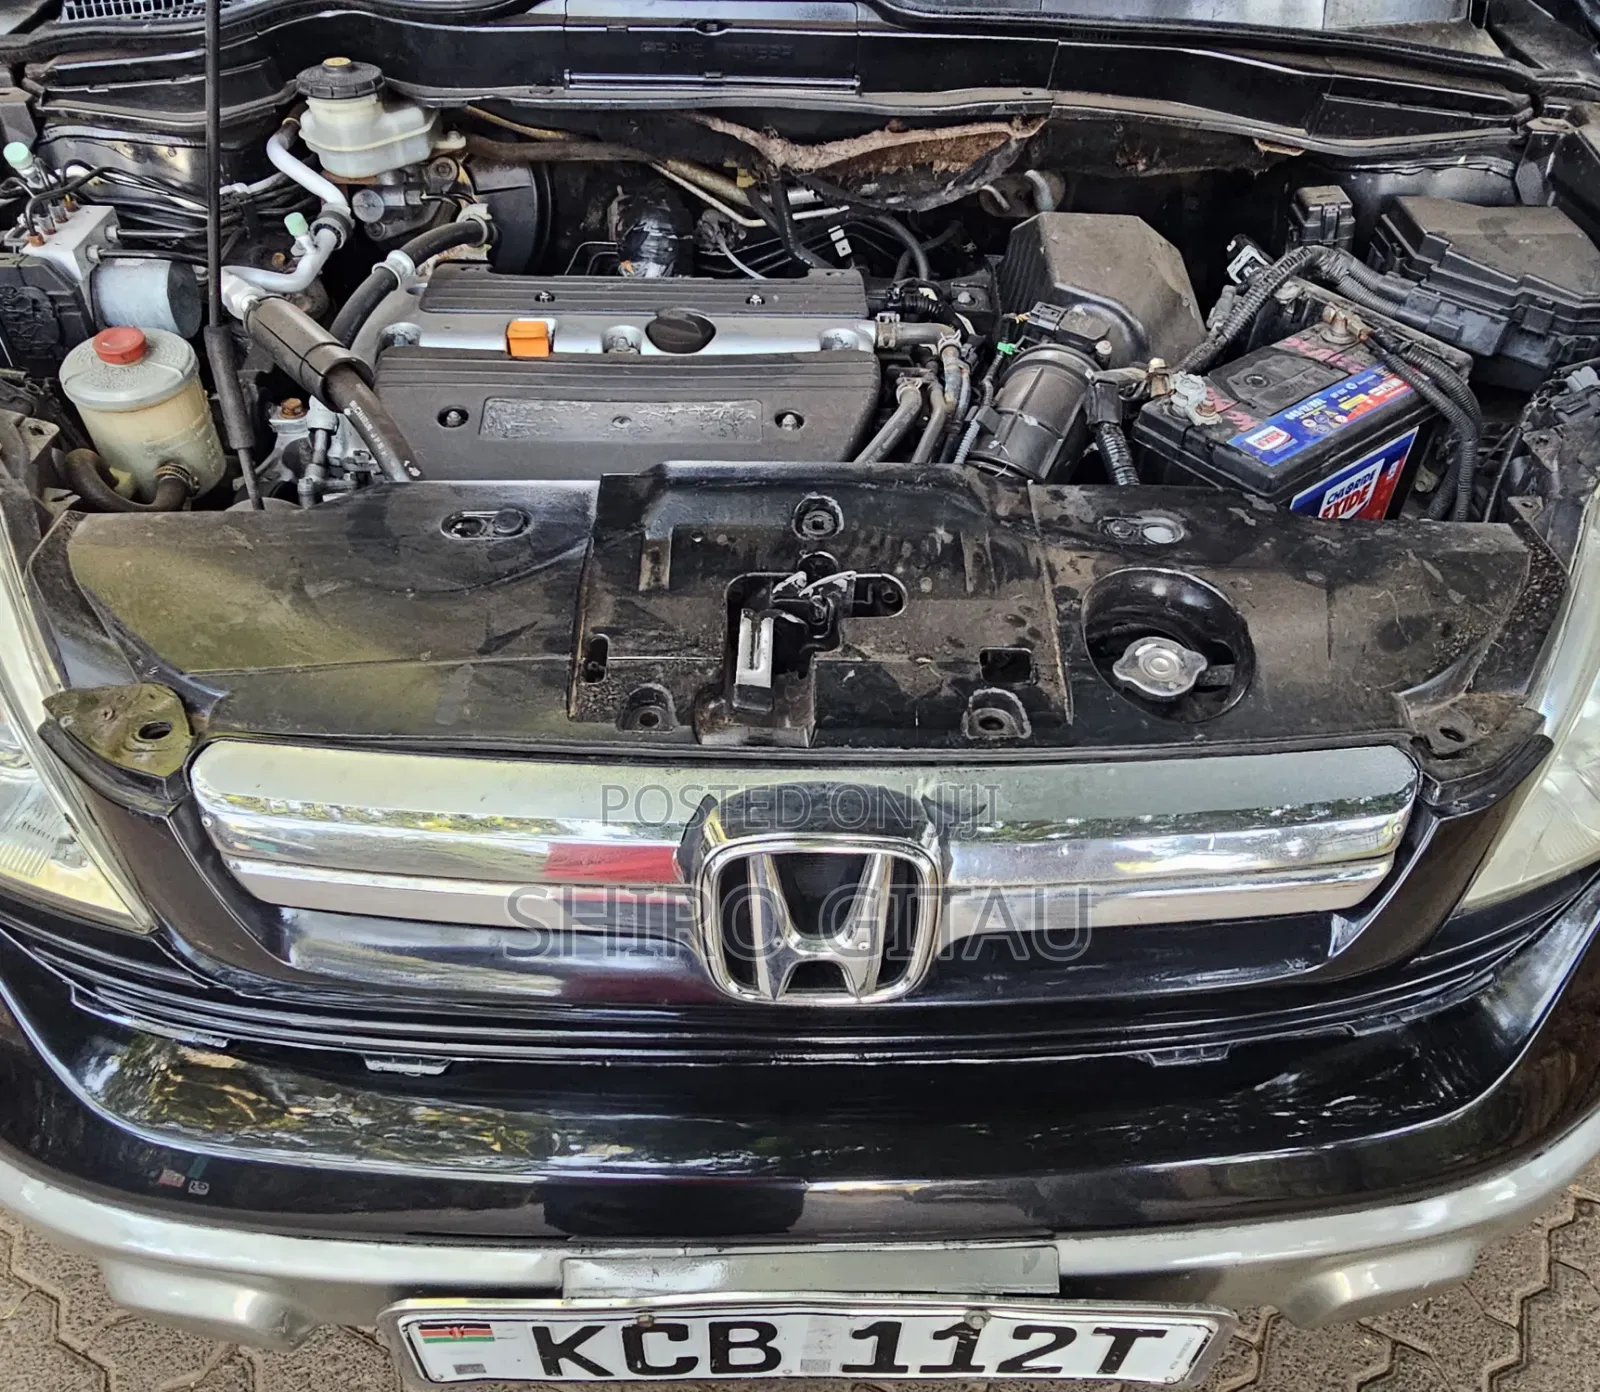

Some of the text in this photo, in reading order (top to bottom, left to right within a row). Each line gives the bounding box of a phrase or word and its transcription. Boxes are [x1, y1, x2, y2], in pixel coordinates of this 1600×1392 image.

[1321, 482, 1371, 518] EXIDE
[1326, 469, 1378, 505] CHLORIDE
[532, 1321, 782, 1377] KCB
[841, 1321, 1168, 1375] 112T
